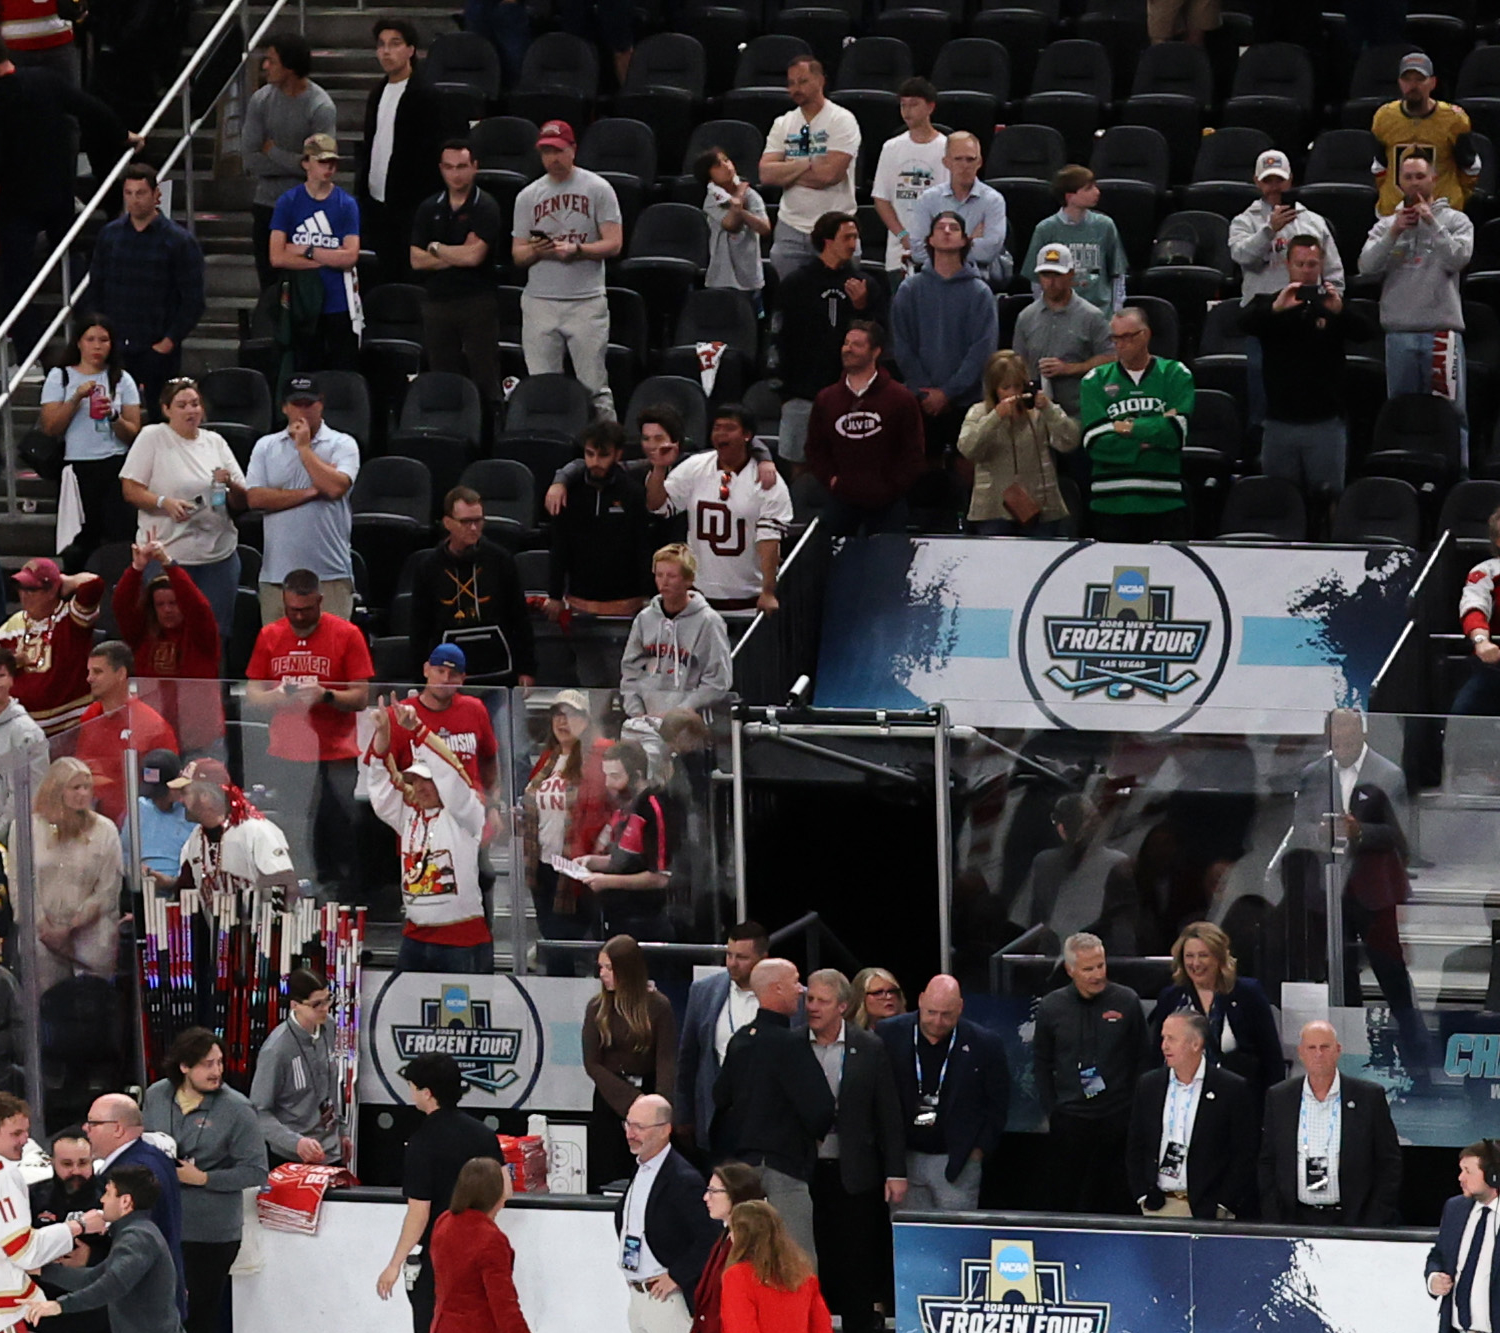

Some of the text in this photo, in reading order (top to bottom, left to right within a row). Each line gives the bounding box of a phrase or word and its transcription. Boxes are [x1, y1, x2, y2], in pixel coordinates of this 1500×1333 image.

[533, 194, 590, 225] DENVER
[291, 230, 339, 248] adidas
[1106, 397, 1168, 419] SIOUX
[696, 500, 746, 557] DU
[1117, 584, 1145, 594] NCAA
[1057, 628, 1197, 654] FROZEN FOUR
[270, 653, 331, 676] DENVER
[1099, 660, 1147, 669] LAS VEGAS
[405, 1036, 512, 1056] FROZEN FOUR
[998, 1262, 1032, 1273] NCAA
[983, 1304, 1045, 1314] 2026 MEN'S
